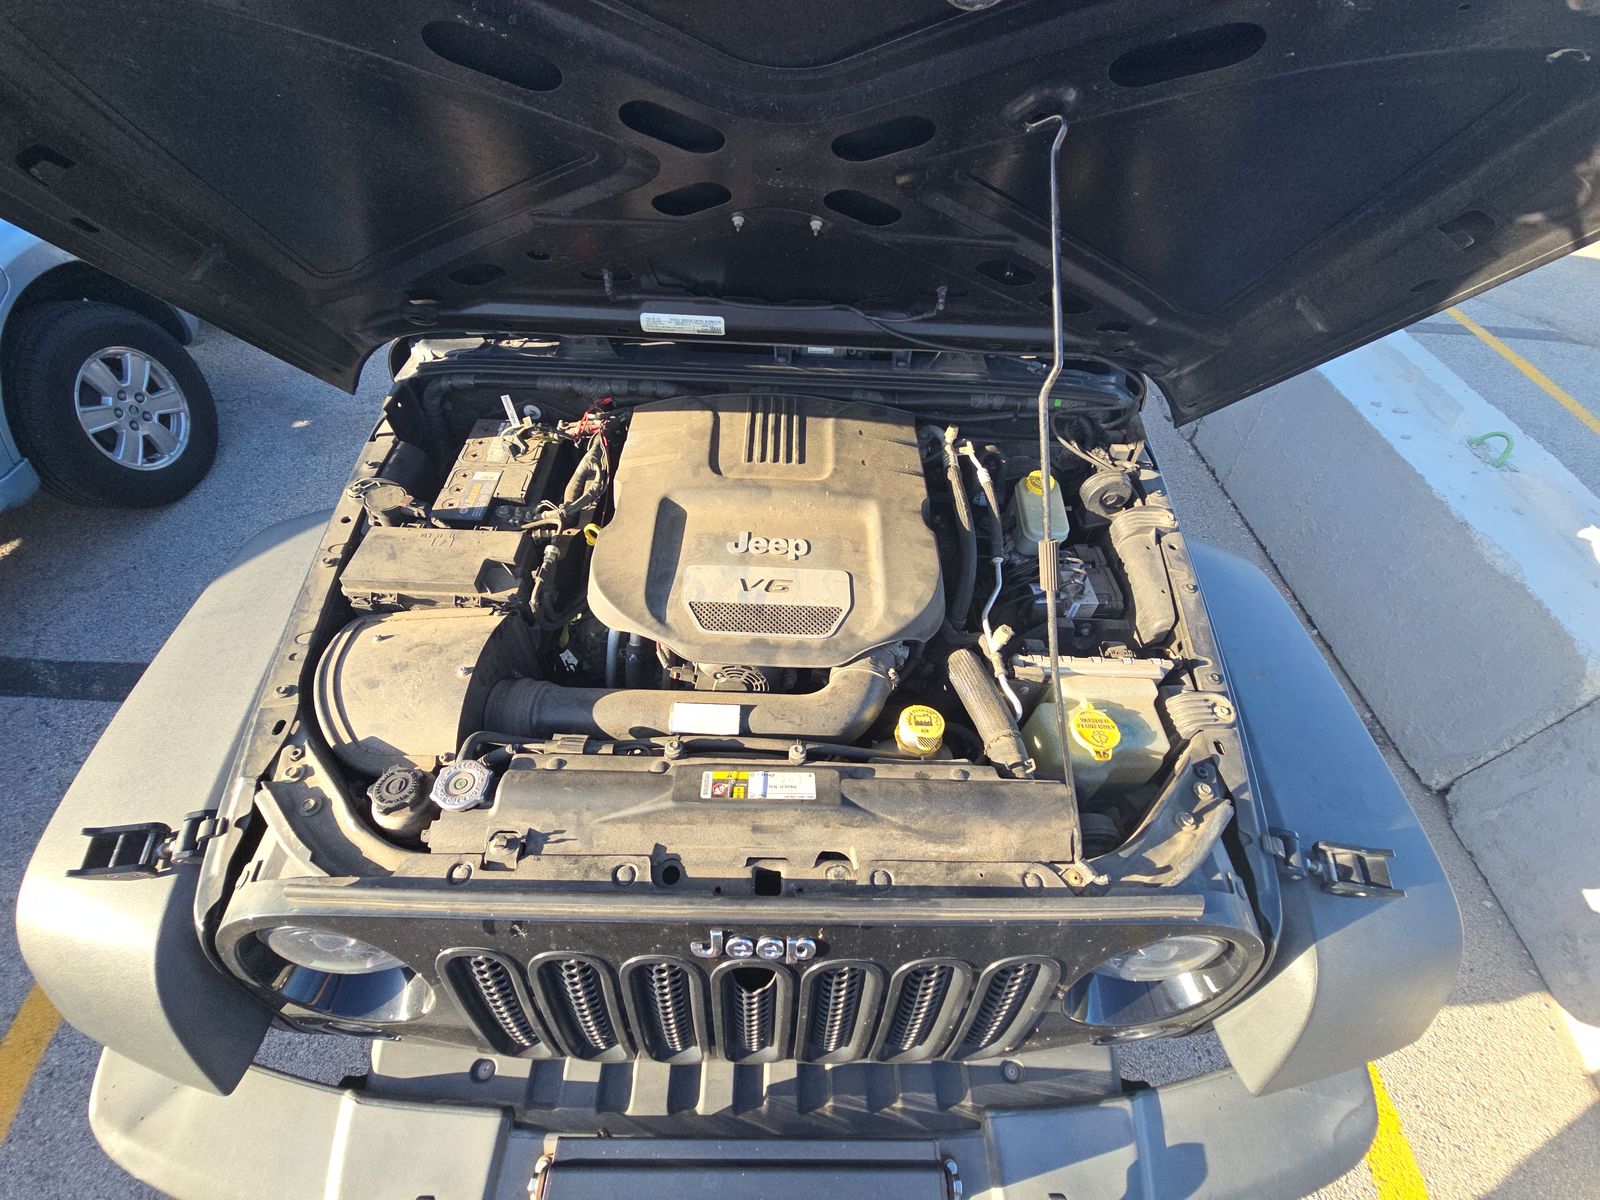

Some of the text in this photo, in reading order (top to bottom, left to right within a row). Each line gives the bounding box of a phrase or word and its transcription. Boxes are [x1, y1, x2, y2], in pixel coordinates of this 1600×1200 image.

[727, 531, 811, 561] Jeep
[739, 578, 794, 593] V6
[690, 930, 817, 965] Jeep
